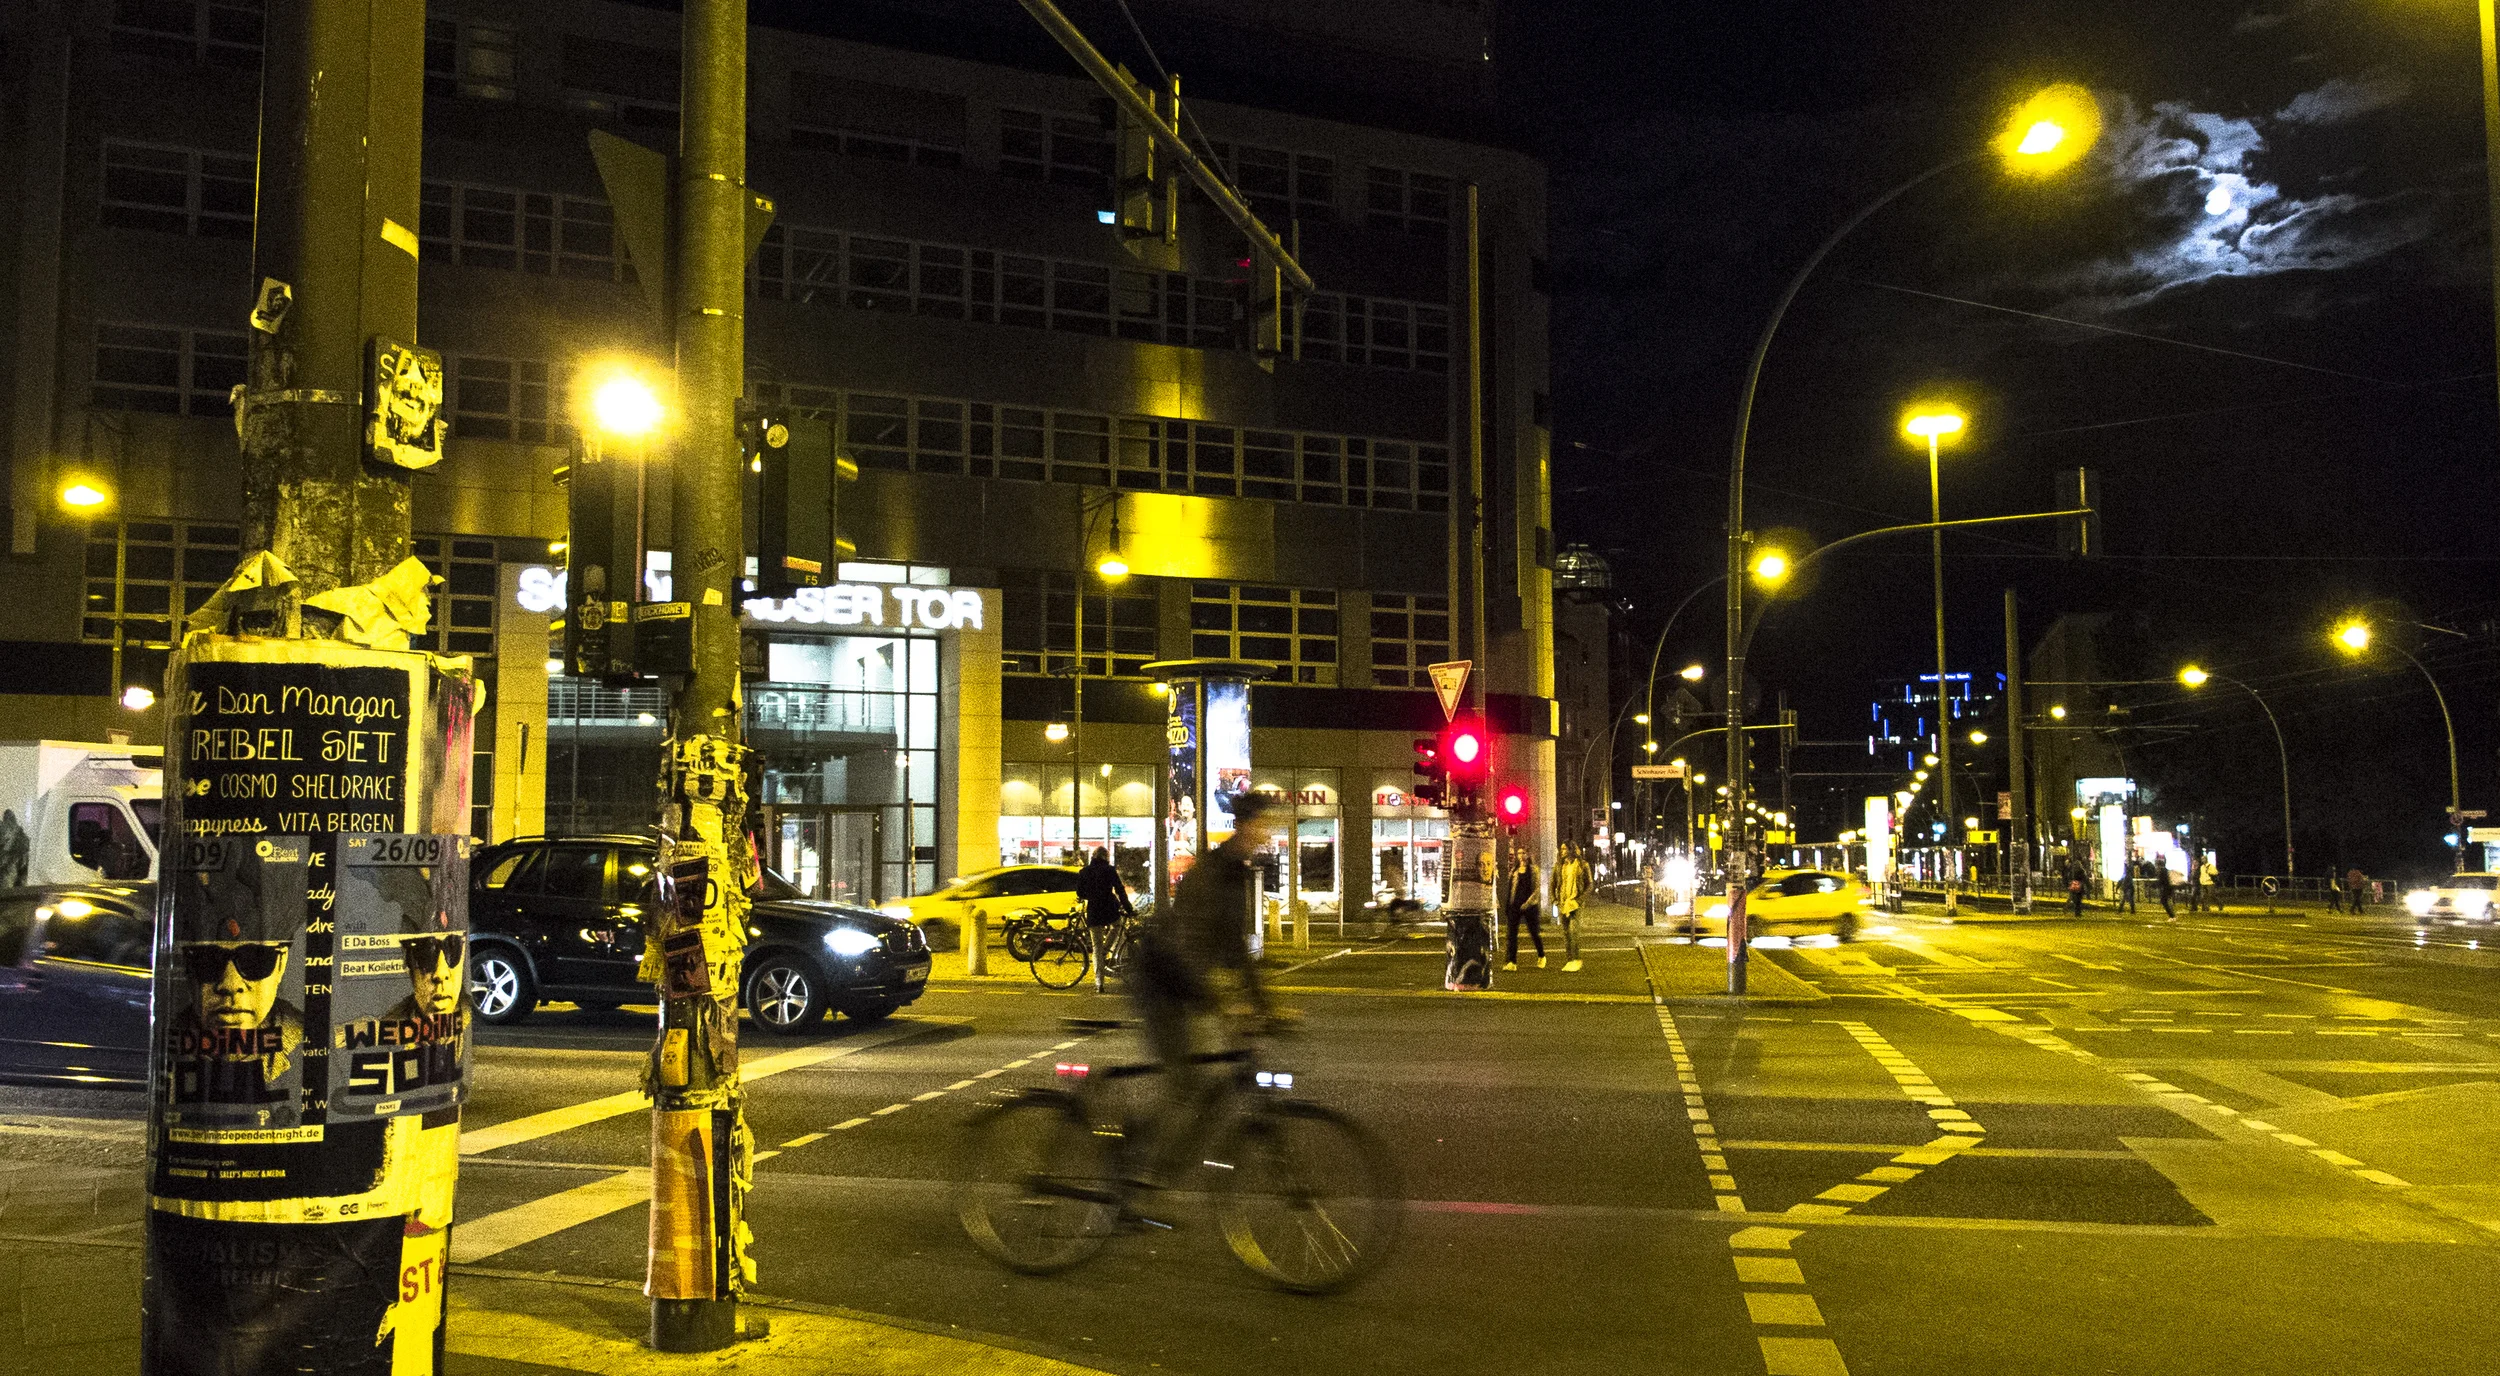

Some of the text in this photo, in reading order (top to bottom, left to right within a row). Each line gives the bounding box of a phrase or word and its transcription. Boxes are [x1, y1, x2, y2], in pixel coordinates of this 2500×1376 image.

[805, 575, 819, 586] F5
[892, 586, 984, 630] TOR
[219, 686, 274, 715] Dan
[281, 685, 402, 724] Mangan
[191, 728, 396, 764] REBEL SET
[220, 773, 277, 800] COSMO
[291, 774, 395, 801] SHELDRAKE
[279, 812, 322, 833] VITA
[328, 812, 394, 834] BERGEN
[349, 838, 368, 848] SAT
[371, 837, 441, 863] 26/09
[344, 935, 391, 948] E Da Boss
[343, 962, 365, 974] Beat
[305, 984, 333, 995] TEN
[348, 1041, 464, 1096] SOUL
